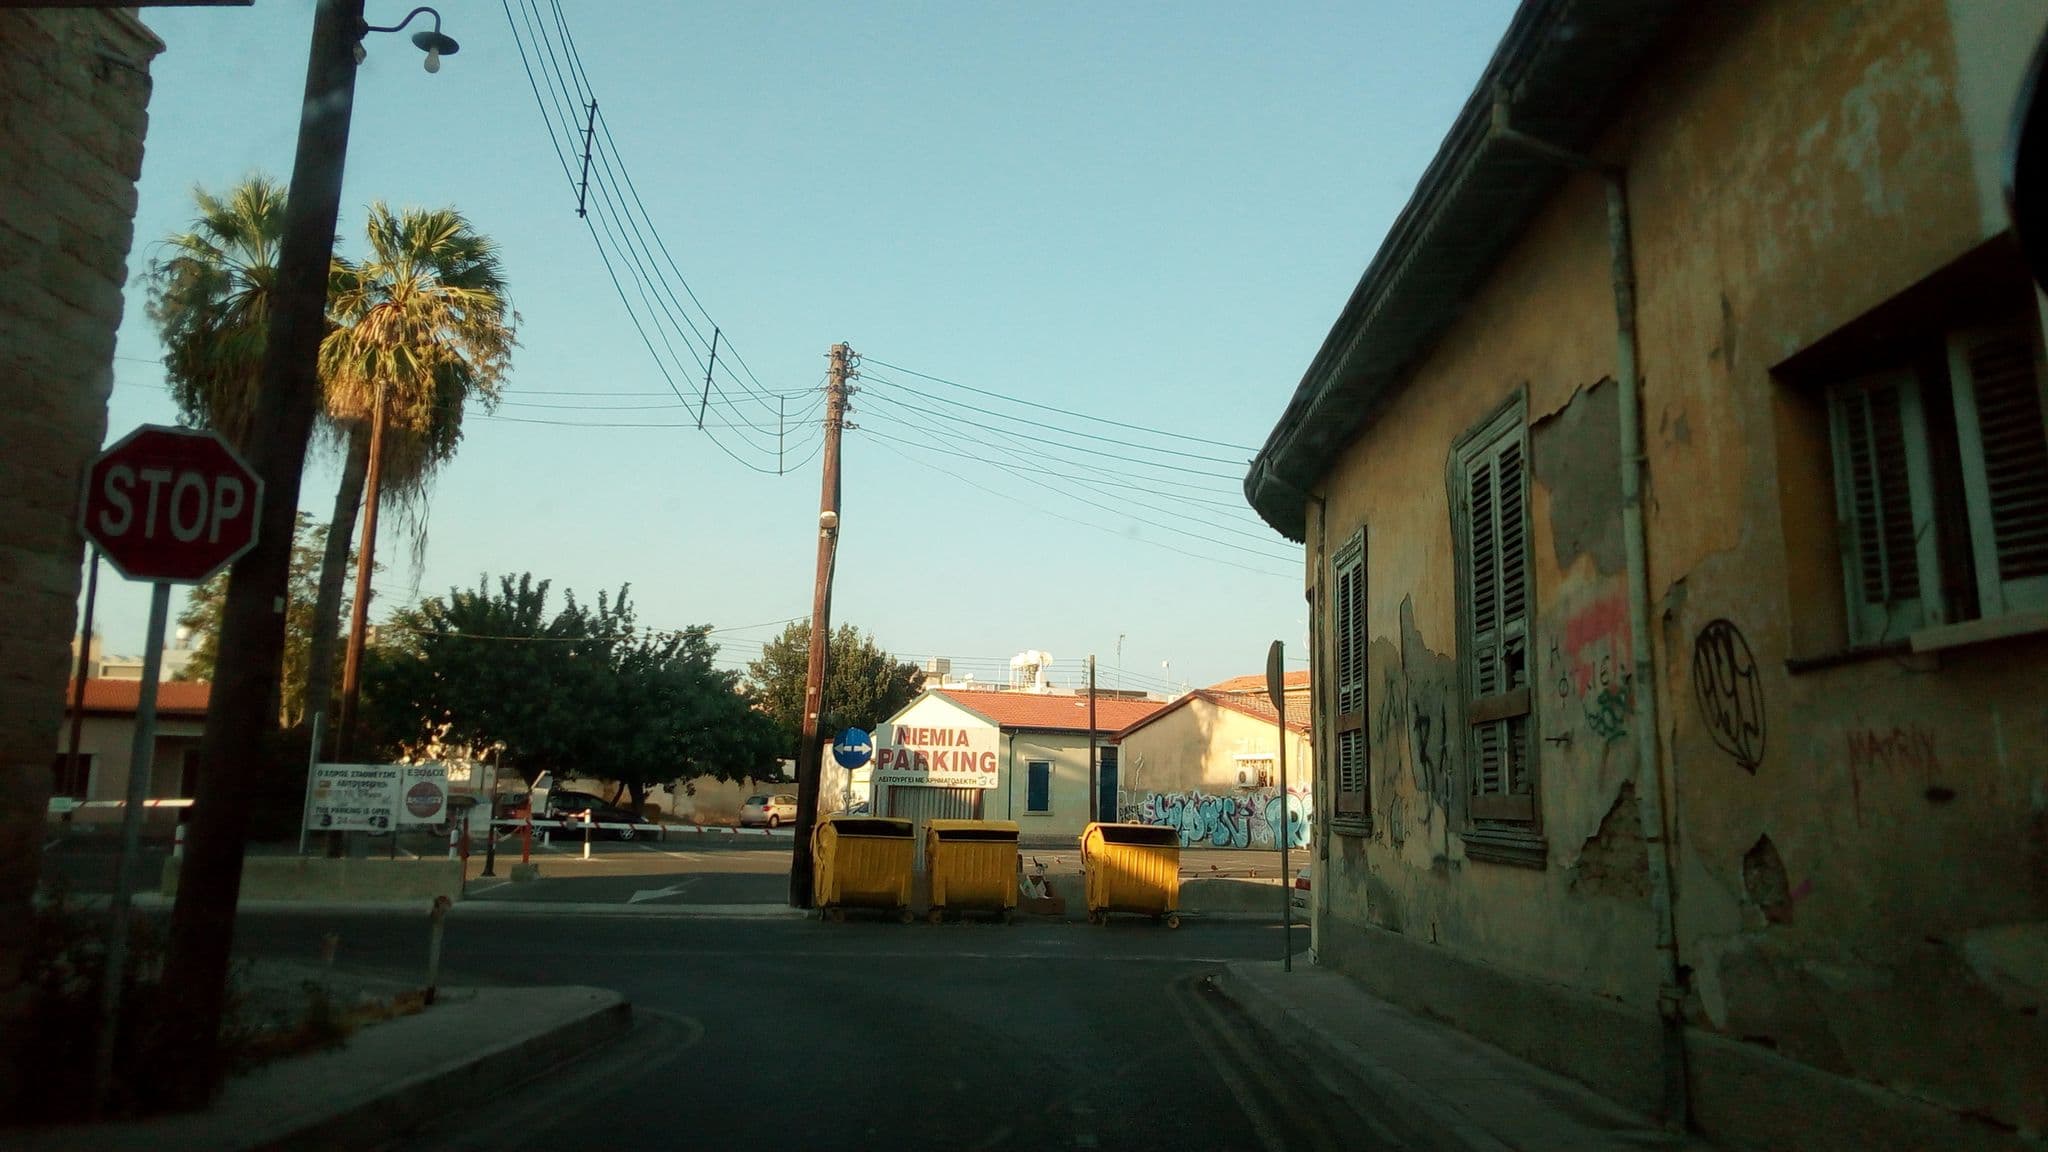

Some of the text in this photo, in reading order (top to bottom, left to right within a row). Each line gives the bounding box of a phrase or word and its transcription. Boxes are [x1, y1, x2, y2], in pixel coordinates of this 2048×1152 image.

[98, 464, 245, 544] STOP
[896, 727, 969, 747] NIEMIA
[877, 748, 997, 773] PARKING
[407, 769, 444, 777] ΕΞΟΔΟΣ
